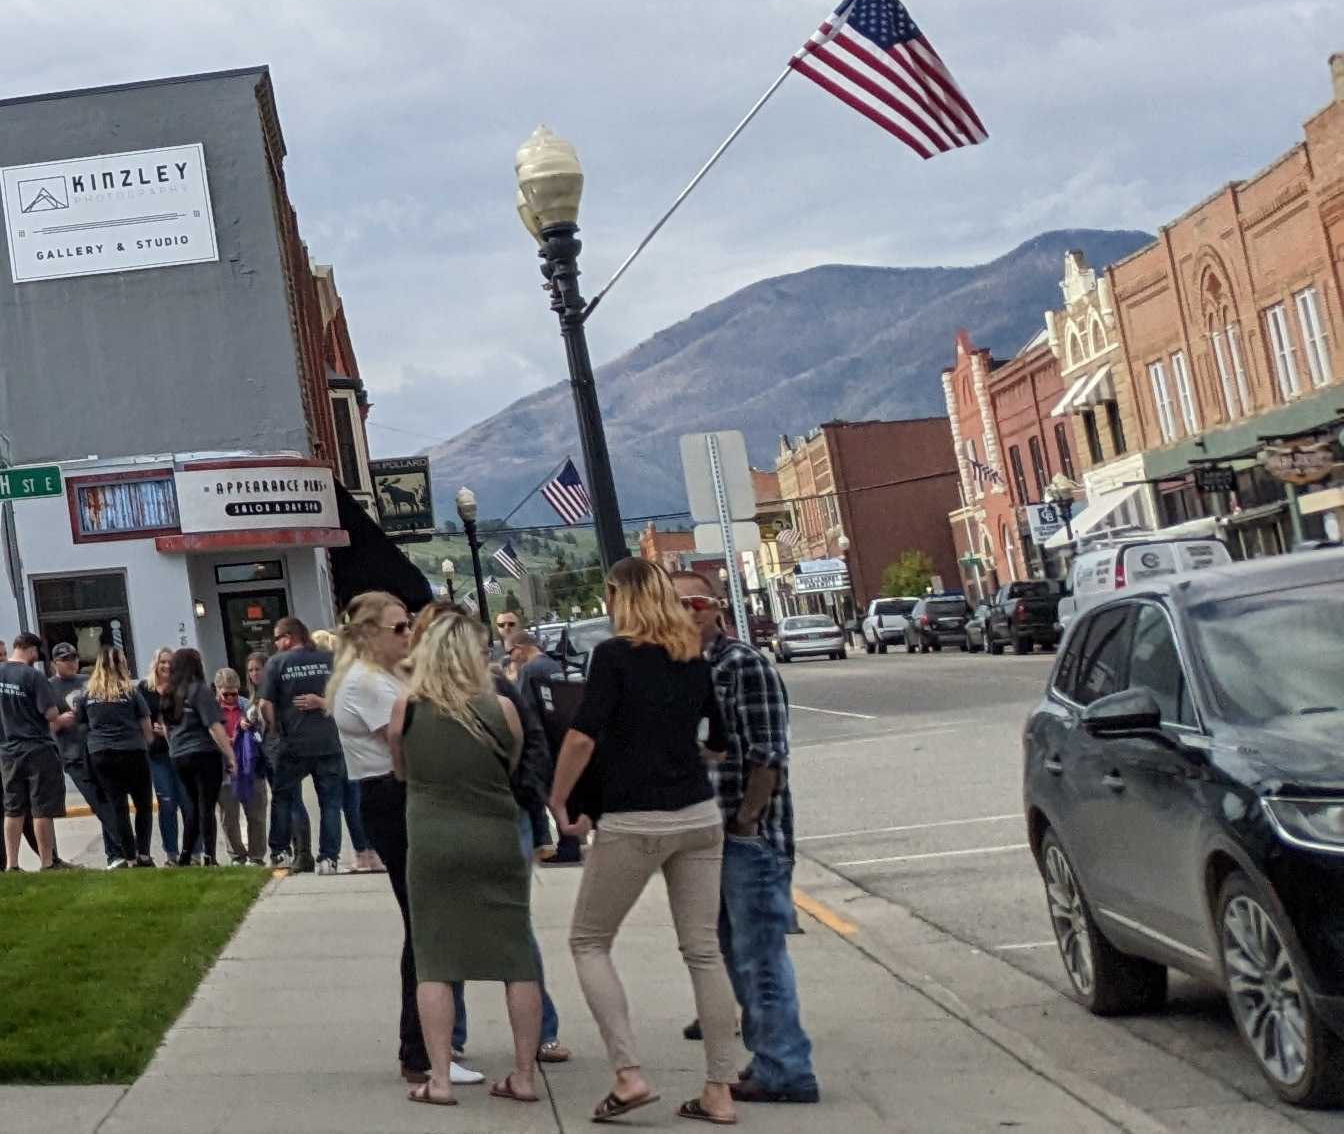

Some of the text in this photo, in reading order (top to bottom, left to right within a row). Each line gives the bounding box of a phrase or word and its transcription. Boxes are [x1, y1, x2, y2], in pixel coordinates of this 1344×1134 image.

[72, 162, 188, 194] KINZLEY
[36, 235, 189, 260] GALLERY & STUDIO
[22, 478, 35, 493] ST
[45, 476, 53, 491] E
[216, 479, 299, 494] APPEARANCE
